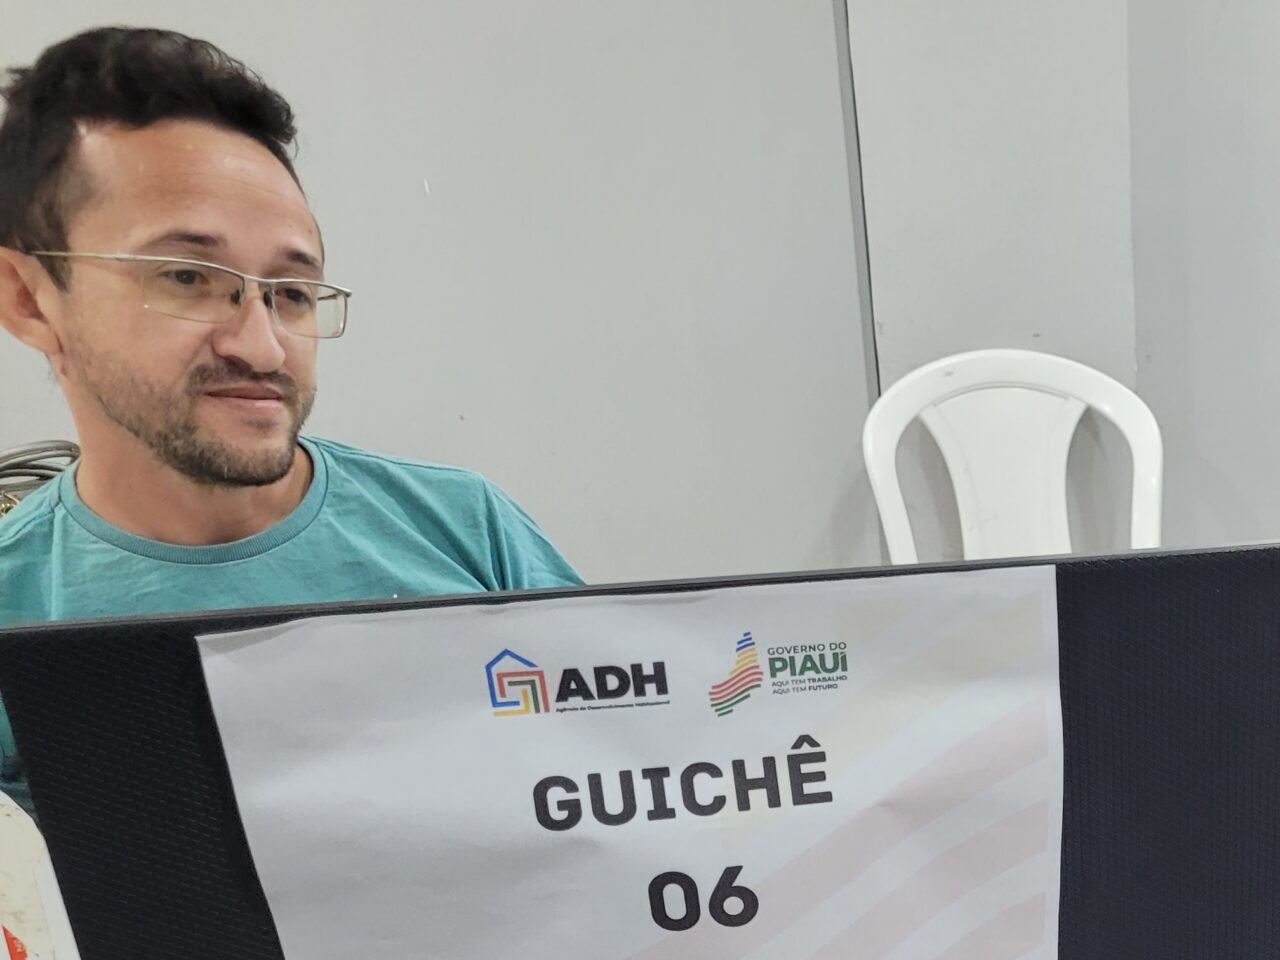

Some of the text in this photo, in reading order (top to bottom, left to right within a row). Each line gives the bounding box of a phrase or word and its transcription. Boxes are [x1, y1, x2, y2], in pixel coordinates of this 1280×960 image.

[767, 642, 847, 656] GOVERNO DO
[768, 651, 848, 678] PIAUÍ
[555, 661, 668, 703] ADH
[772, 675, 848, 688] AQUI TEM TRABALHO
[808, 683, 838, 692] FUTURO
[532, 734, 833, 832] GUICHÊ
[648, 865, 759, 932] 06
